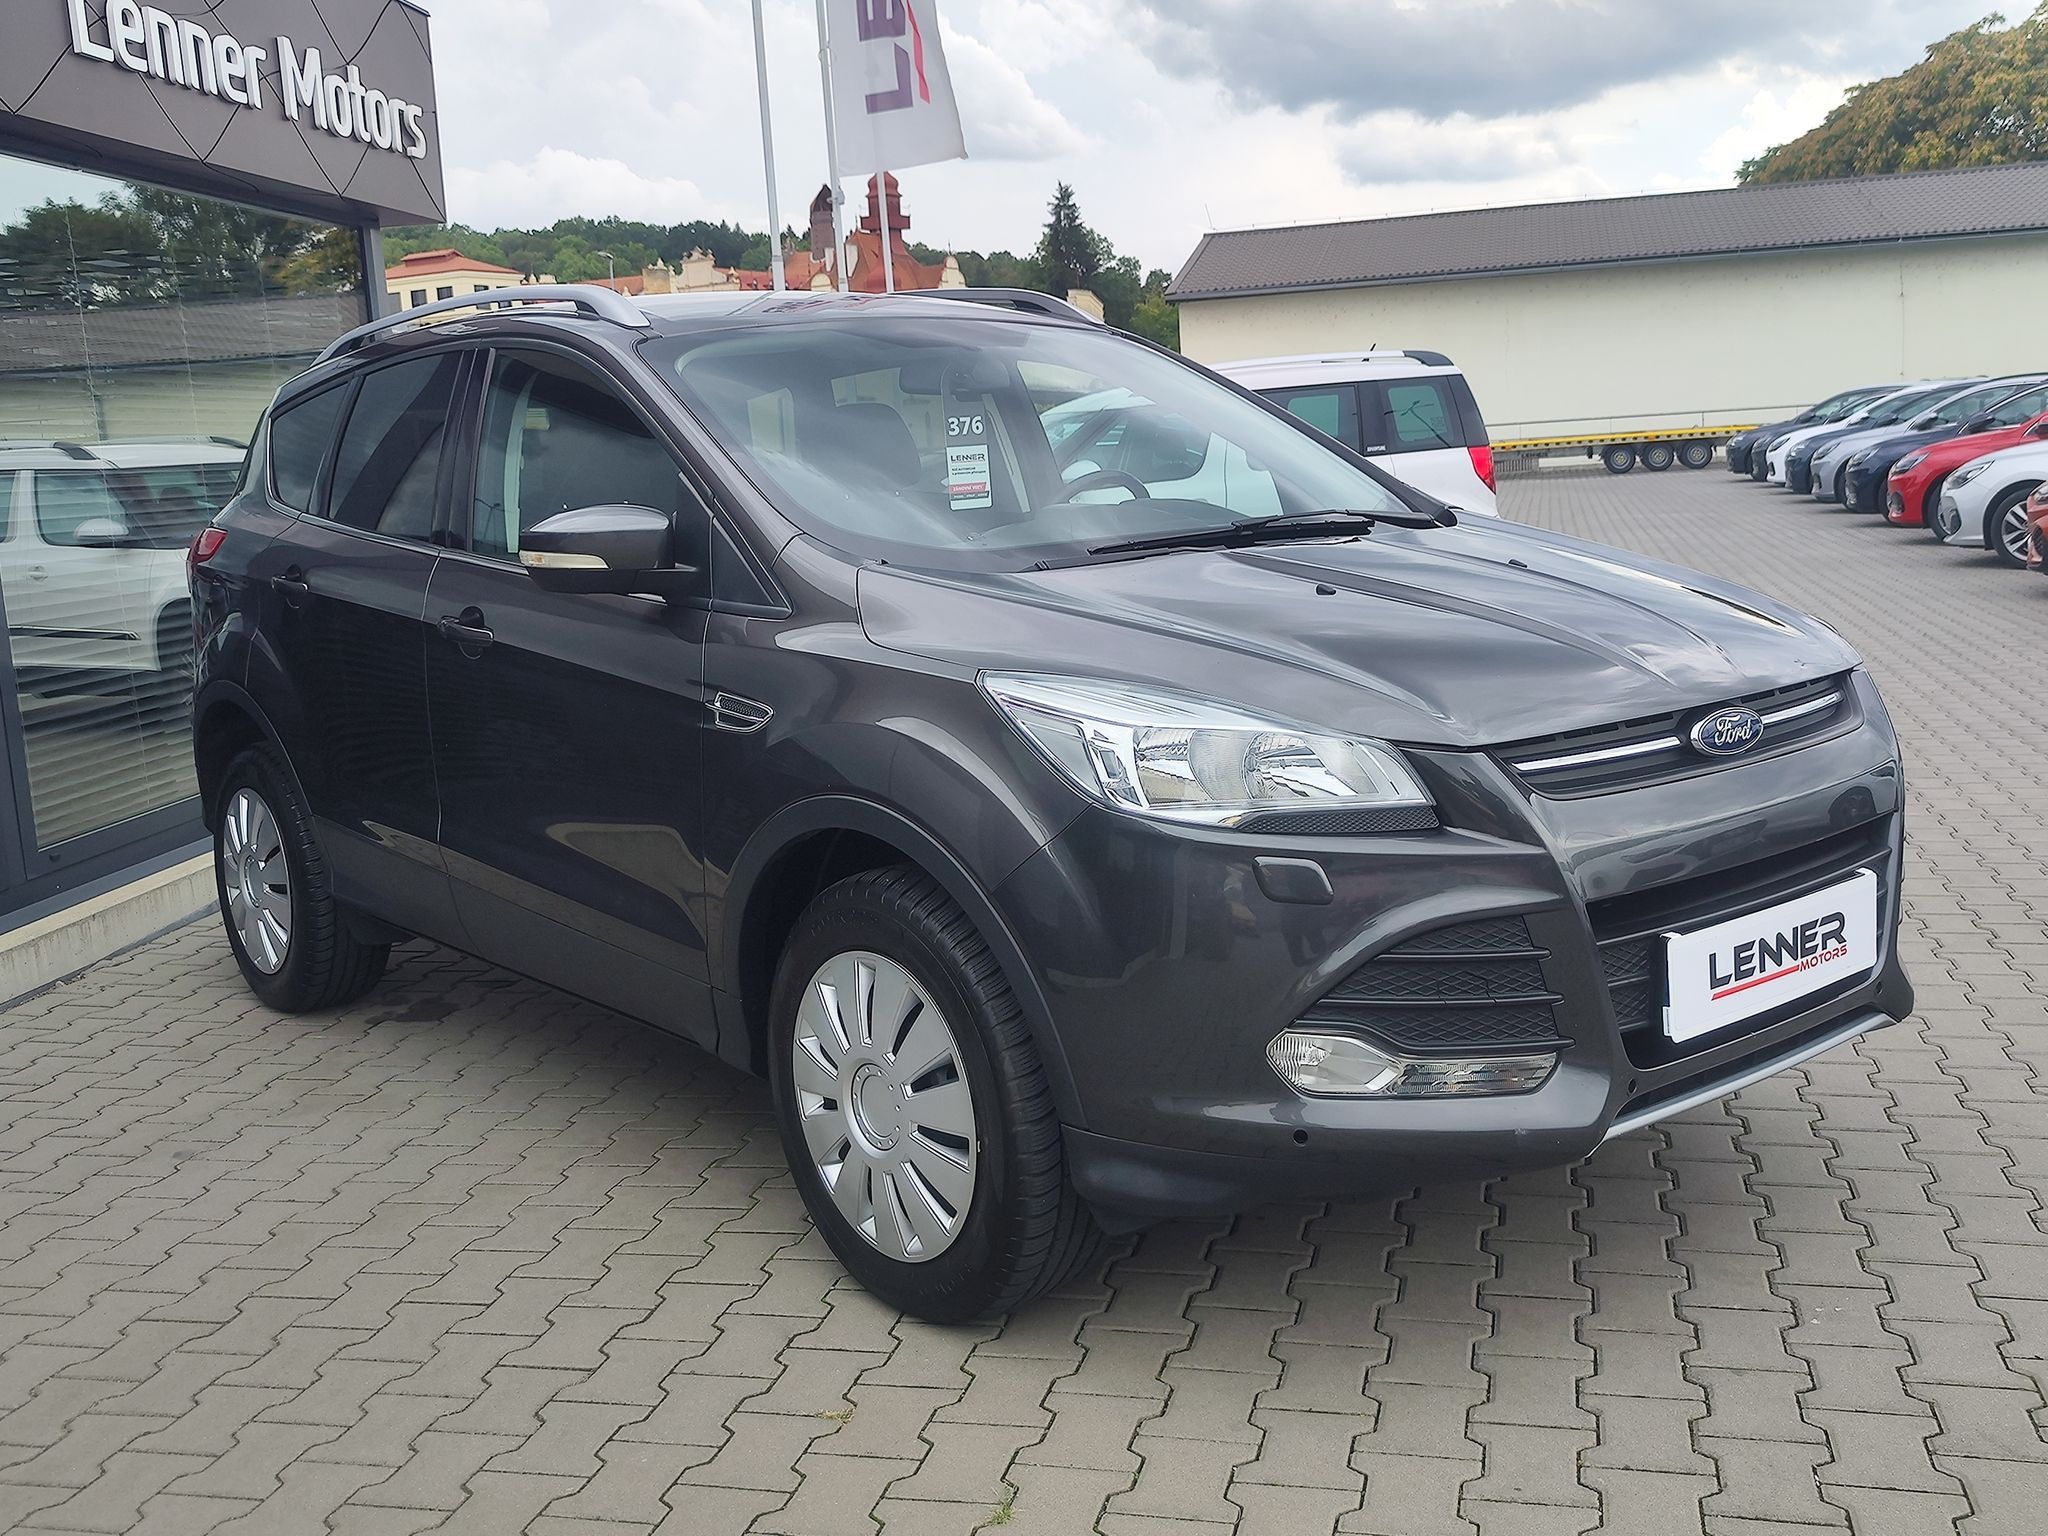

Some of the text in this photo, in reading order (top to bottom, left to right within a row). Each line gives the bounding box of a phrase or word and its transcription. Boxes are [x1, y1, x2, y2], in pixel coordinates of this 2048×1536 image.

[66, 0, 428, 160] Lenner Motors
[947, 415, 984, 437] 376
[1714, 713, 1753, 747] Ford
[1708, 911, 1848, 990] LENNER
[1799, 943, 1848, 972] MOTORS
